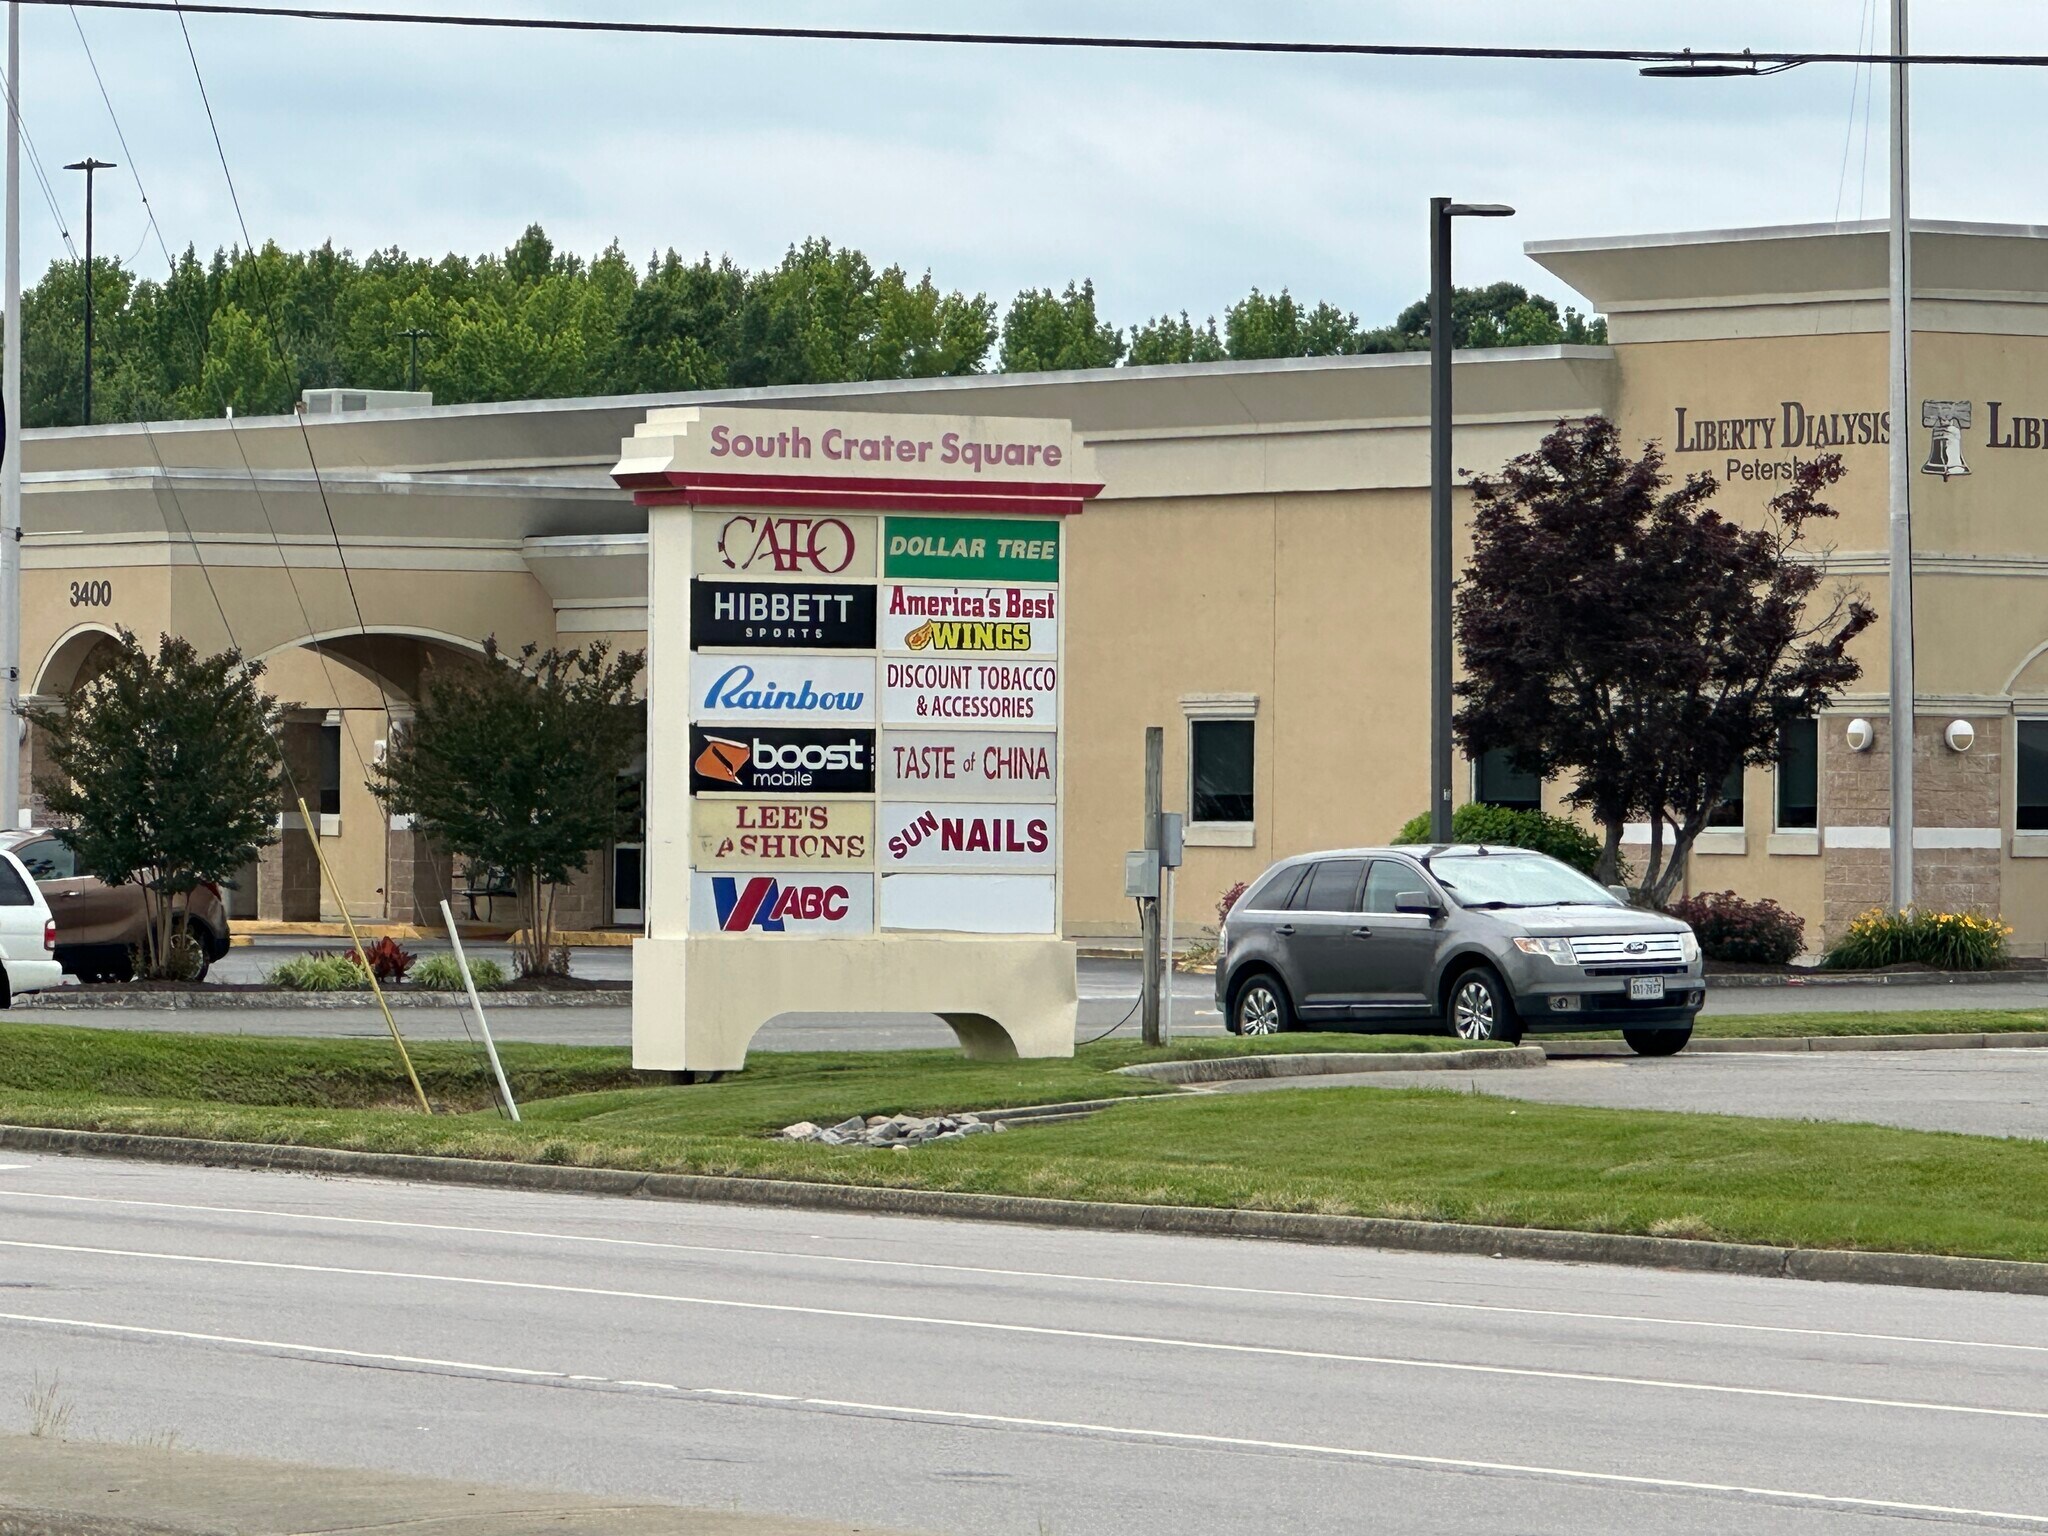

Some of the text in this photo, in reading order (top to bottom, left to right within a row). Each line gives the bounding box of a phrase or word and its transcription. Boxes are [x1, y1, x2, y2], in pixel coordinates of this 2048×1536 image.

[1675, 407, 1776, 452] LIBERTY
[710, 425, 1063, 473] South Crater Square
[718, 515, 856, 574] CATO
[889, 536, 1056, 560] DOLLAR TREE
[70, 580, 112, 607] 3400
[714, 592, 854, 623] HIBBETT
[889, 585, 1055, 619] America's Best
[745, 627, 823, 639] SPORTS
[930, 621, 1032, 651] WINGS
[703, 665, 864, 711] Rainbow
[887, 664, 1056, 692] DISCOUNT TOBACCO
[916, 695, 1034, 718] & ACCESSORIES
[752, 737, 864, 771] boost
[893, 746, 956, 780] TASTE
[963, 751, 976, 773] of
[983, 746, 1051, 780] CHINA
[752, 771, 813, 787] mobile
[736, 805, 829, 830] LEE'S
[699, 834, 866, 860] ASHIONS
[888, 810, 1049, 860] SUN NAILS
[768, 885, 850, 922] ABC
